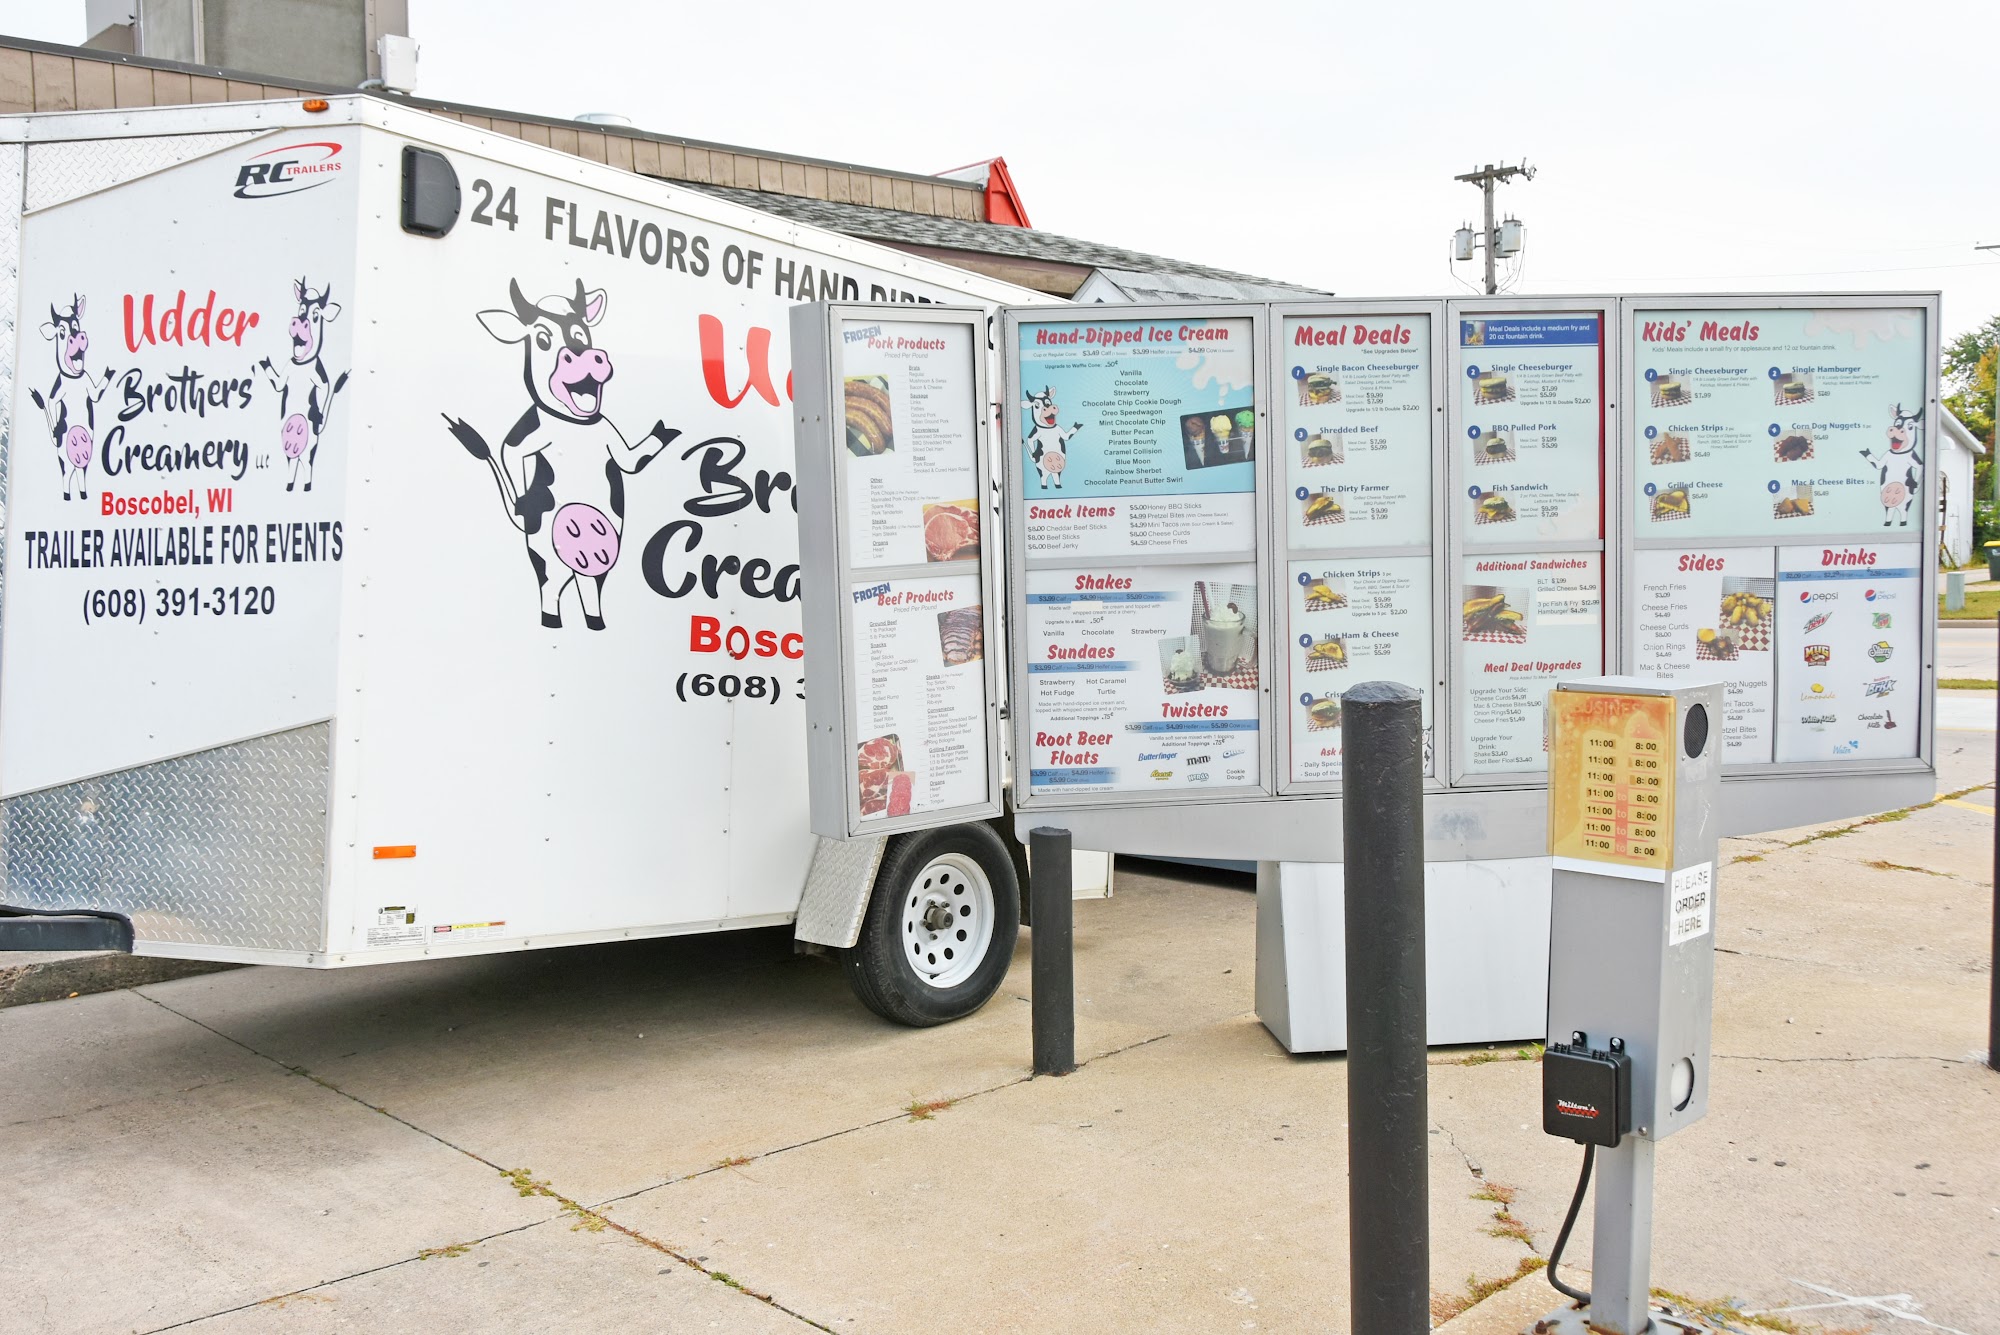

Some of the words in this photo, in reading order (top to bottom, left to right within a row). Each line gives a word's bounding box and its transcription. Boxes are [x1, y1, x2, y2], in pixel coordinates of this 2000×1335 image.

[236, 160, 300, 187] RC
[286, 162, 342, 176] TRAILERS
[471, 178, 519, 231] 24
[545, 197, 710, 277] FLAVORS
[722, 244, 763, 288] OF
[775, 258, 859, 302] HAND
[123, 289, 260, 353] Udder
[843, 325, 881, 343] FROZEN
[1037, 327, 1143, 347] Hand-Dipped
[1148, 327, 1172, 341] Ice
[1179, 325, 1228, 341] Cream
[1295, 325, 1347, 346] Meal
[1353, 324, 1411, 345] Deals
[1642, 320, 1692, 342] Kids'
[1700, 321, 1759, 341] Meals
[868, 336, 893, 349] Pork
[897, 337, 946, 350] Products
[1492, 364, 1515, 372] Single
[116, 365, 257, 422] Brothers'
[1668, 424, 1698, 432] Chicken
[1701, 424, 1724, 432] Strips
[1811, 422, 1827, 431] Dog
[1829, 422, 1861, 430] Nuggets
[101, 426, 250, 481] Creamery
[1338, 485, 1358, 493] Dirty
[1809, 478, 1816, 486] &
[1818, 478, 1844, 486] Cheese
[101, 489, 199, 519] Boscobel,
[207, 488, 232, 514] WI
[1030, 506, 1072, 519] Snack
[1077, 505, 1115, 518] Items
[25, 530, 104, 568] TRAILER
[110, 526, 213, 566] AVAILABLE
[220, 524, 259, 564] FOR
[265, 521, 343, 563] EVENTS
[642, 520, 801, 602] Crea
[1476, 561, 1526, 571] Additional
[1530, 559, 1587, 570] Sandwiches
[1678, 554, 1724, 572] Sides
[1822, 548, 1876, 566] Drinks
[1075, 574, 1132, 590] Shakes
[1668, 583, 1686, 591] Fries
[853, 582, 891, 603] FROZEN
[878, 593, 903, 606] Beef
[906, 590, 954, 603] Products
[1812, 592, 1838, 602] pepsi
[83, 589, 146, 625] (608)
[156, 586, 275, 617] 391-3120
[1048, 644, 1115, 660] Sundaes
[1484, 663, 1508, 673] Meal
[1511, 662, 1533, 672] Deal
[1536, 661, 1581, 672] Upgrades
[676, 673, 781, 704] (608)
[1737, 680, 1767, 689] Nuggets
[1162, 703, 1228, 718] Twisters
[1036, 732, 1072, 747] Root
[1077, 731, 1113, 745] Beer
[1051, 752, 1099, 765] Floats
[1138, 752, 1178, 762] Butterfinger
[1617, 810, 1626, 818] to
[1617, 827, 1626, 836] to
[1674, 871, 1708, 892] PLEASE
[1675, 892, 1706, 914] ORDER
[1678, 916, 1701, 936] HERE
